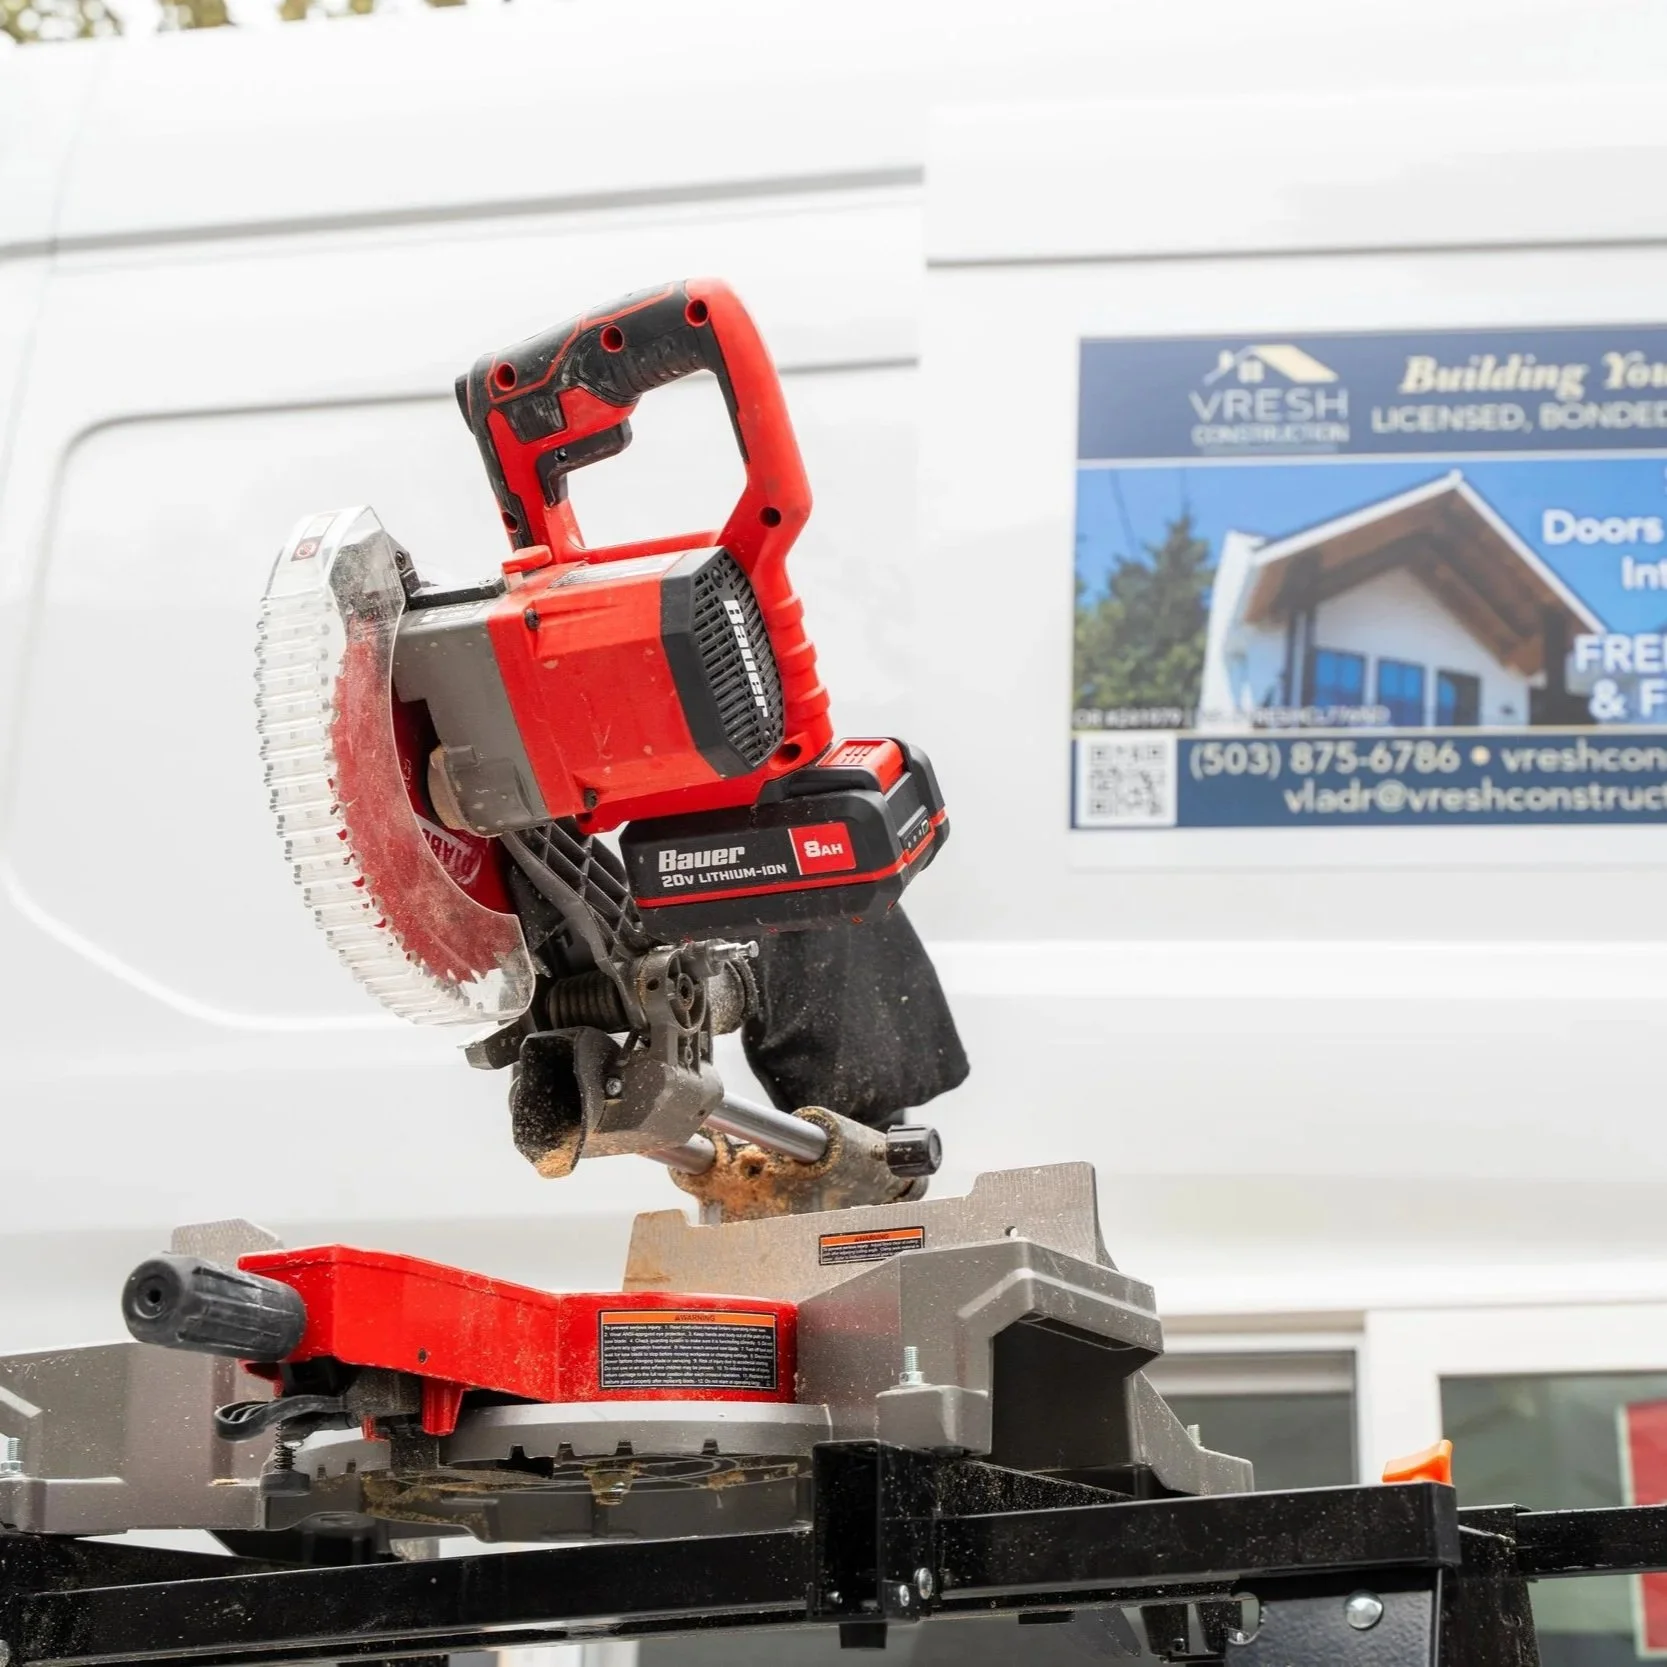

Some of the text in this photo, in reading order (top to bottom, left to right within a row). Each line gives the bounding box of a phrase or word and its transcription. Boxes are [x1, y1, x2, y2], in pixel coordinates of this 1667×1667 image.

[1399, 353, 1587, 402] Building
[1188, 387, 1348, 422] VRESH
[1371, 403, 1533, 434] LICENSED,
[1192, 422, 1350, 446] CONSTRUCTION
[1541, 508, 1664, 545] Doors
[1588, 678, 1628, 720] &
[1190, 741, 1282, 781] (503)
[1289, 740, 1461, 775] 875-6786
[657, 845, 746, 873] Bauer
[803, 840, 844, 859] 8AH
[661, 863, 788, 888] 20V LITHIUM-ION
